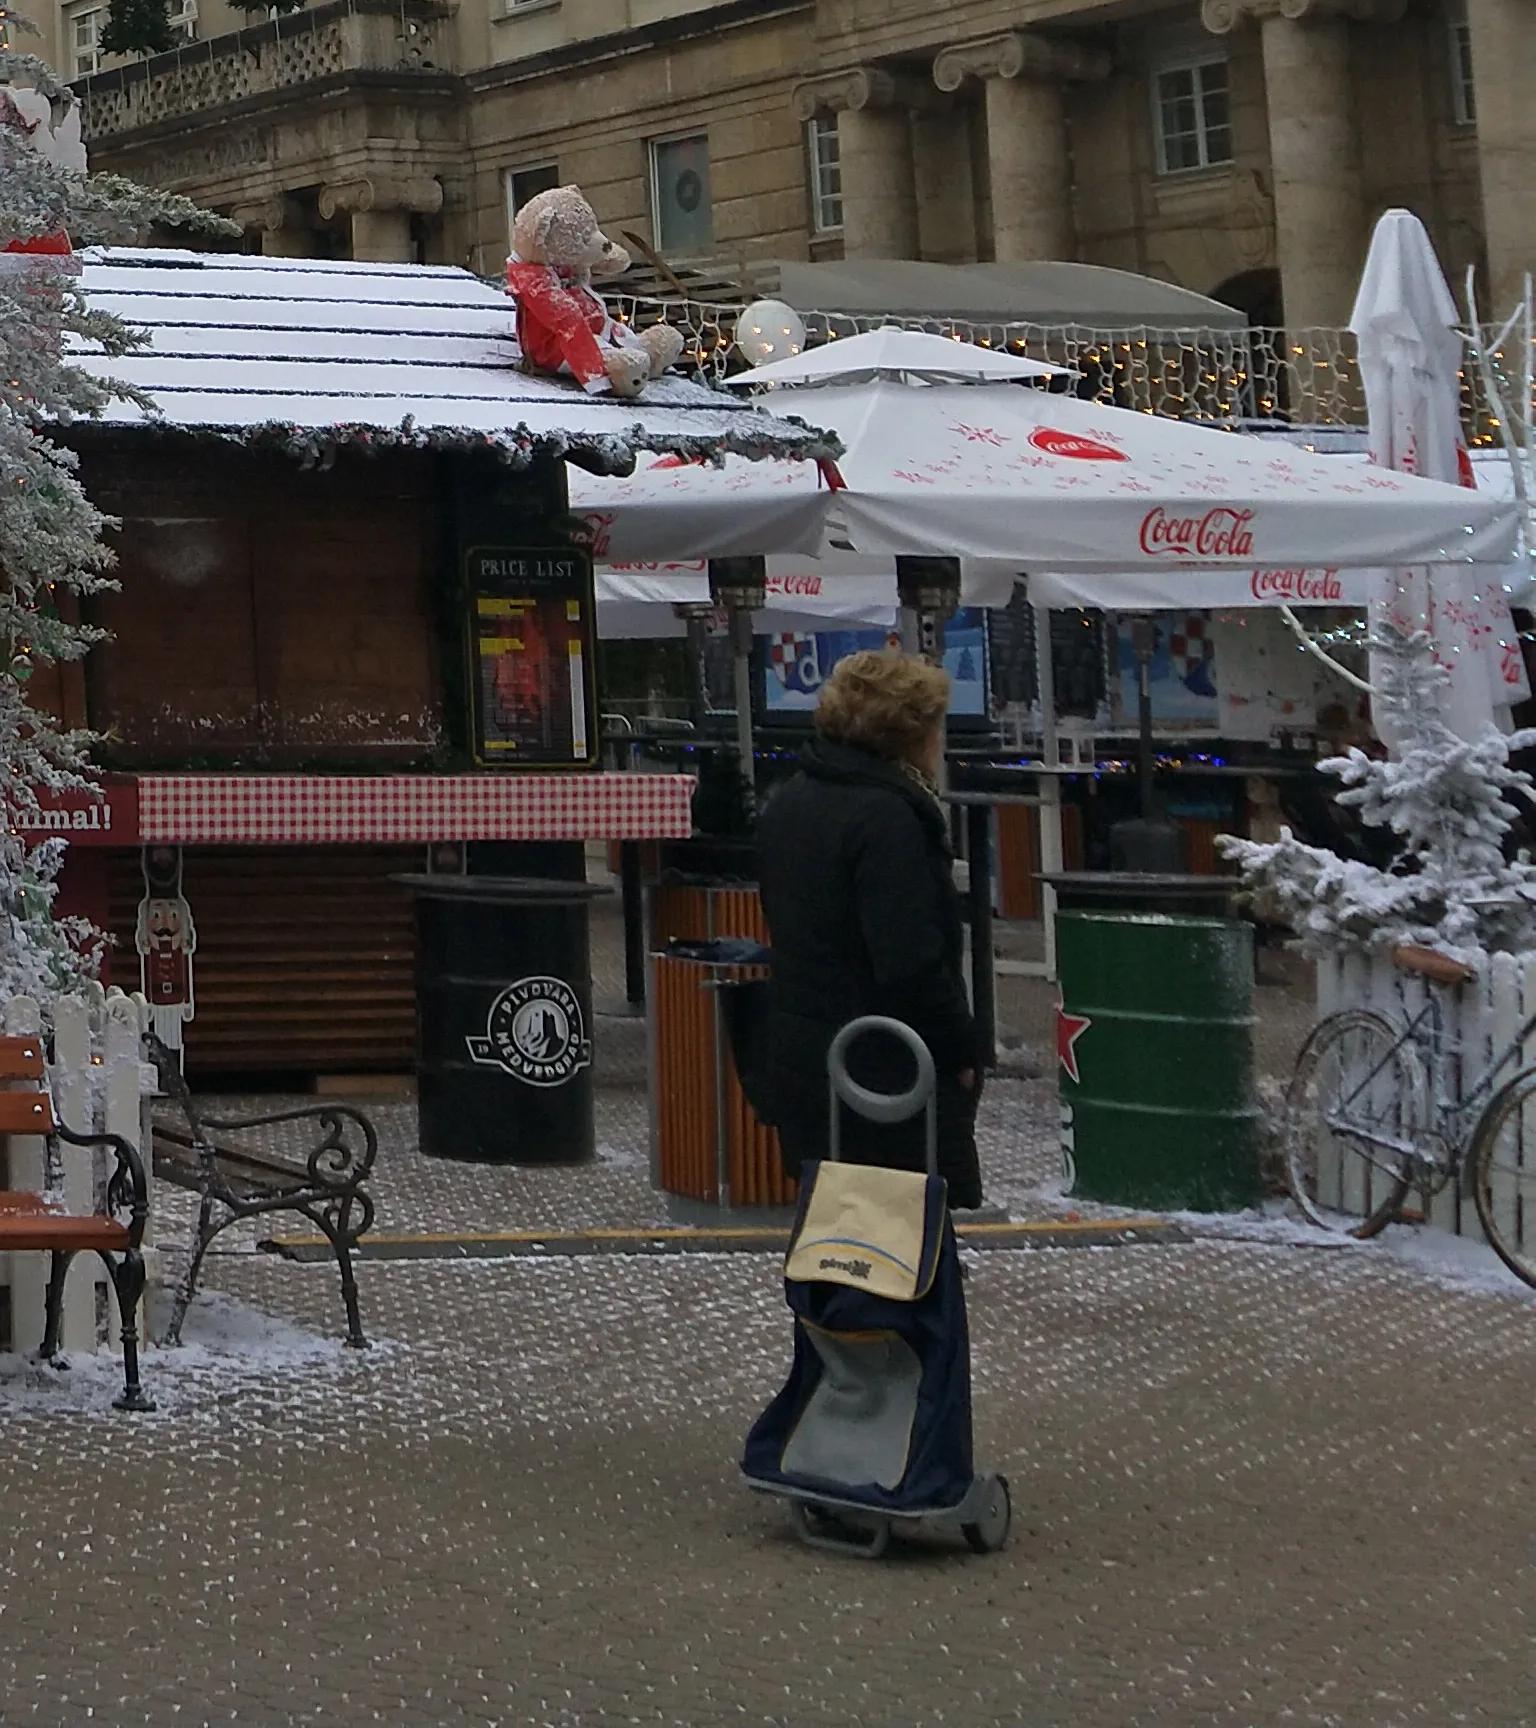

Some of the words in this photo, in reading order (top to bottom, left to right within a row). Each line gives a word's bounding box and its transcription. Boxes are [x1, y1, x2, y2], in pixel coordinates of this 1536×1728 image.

[1139, 506, 1257, 555] Coca-Cola
[480, 559, 528, 576] PRICE
[536, 560, 575, 577] LIST
[500, 982, 575, 1015] PIVOVARA
[496, 1031, 580, 1077] MEDVEDGRAD
